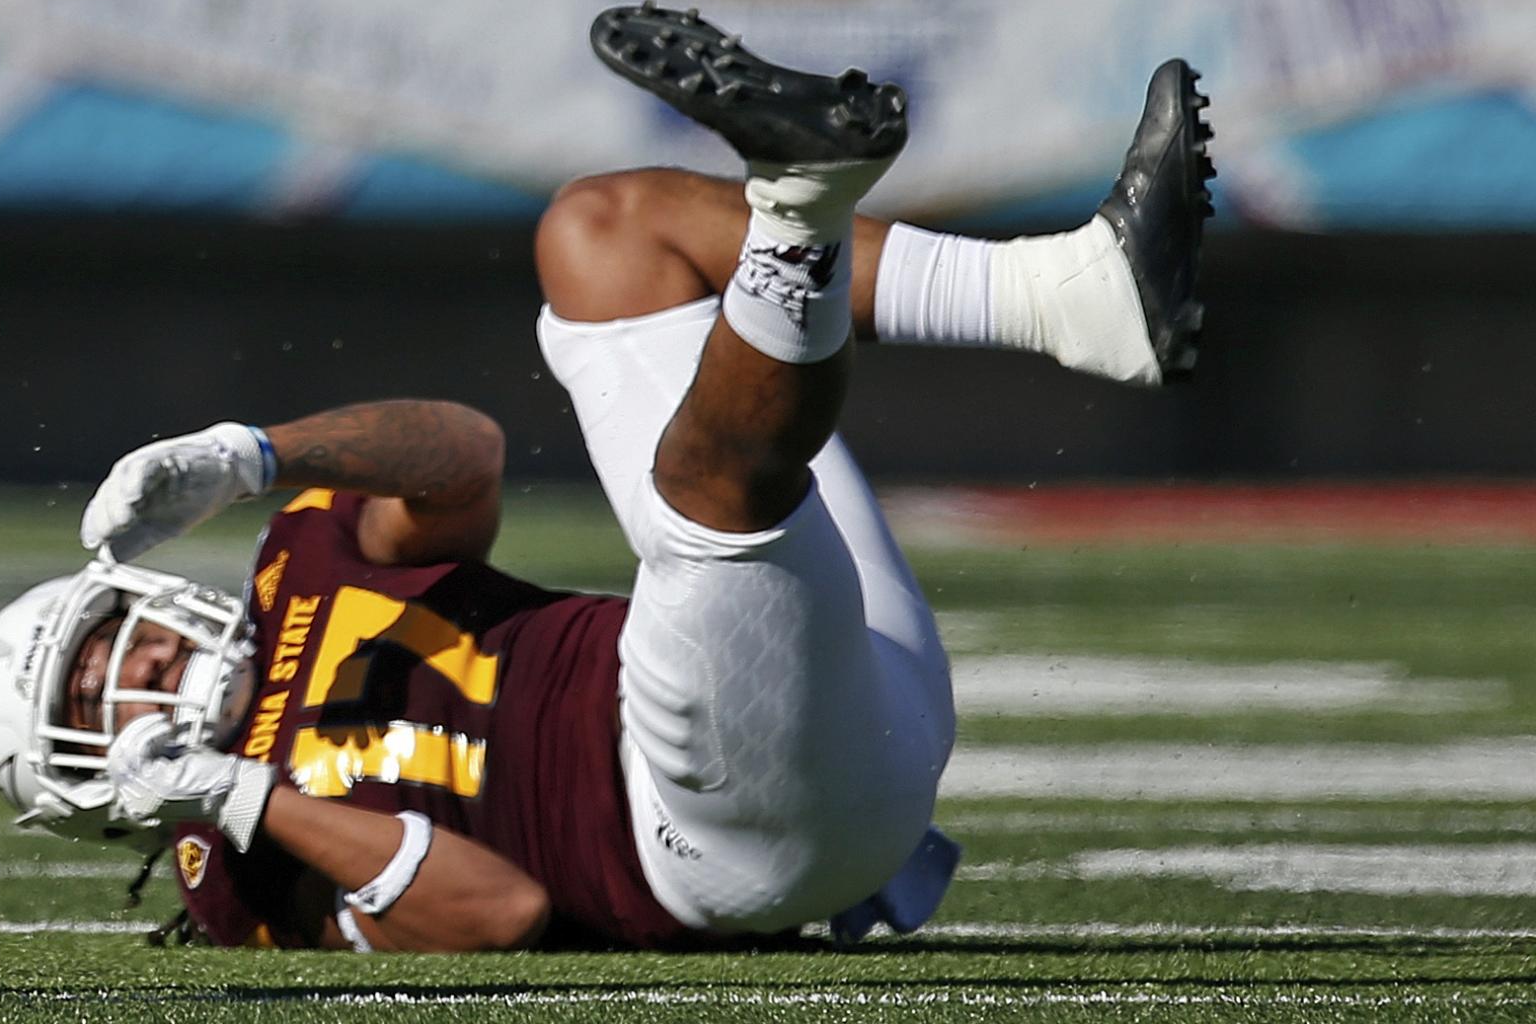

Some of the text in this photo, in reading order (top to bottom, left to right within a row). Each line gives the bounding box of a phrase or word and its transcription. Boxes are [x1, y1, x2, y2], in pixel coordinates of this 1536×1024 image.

[244, 689, 291, 763] ONA
[269, 594, 322, 682] STATE
[289, 585, 501, 799] 17
